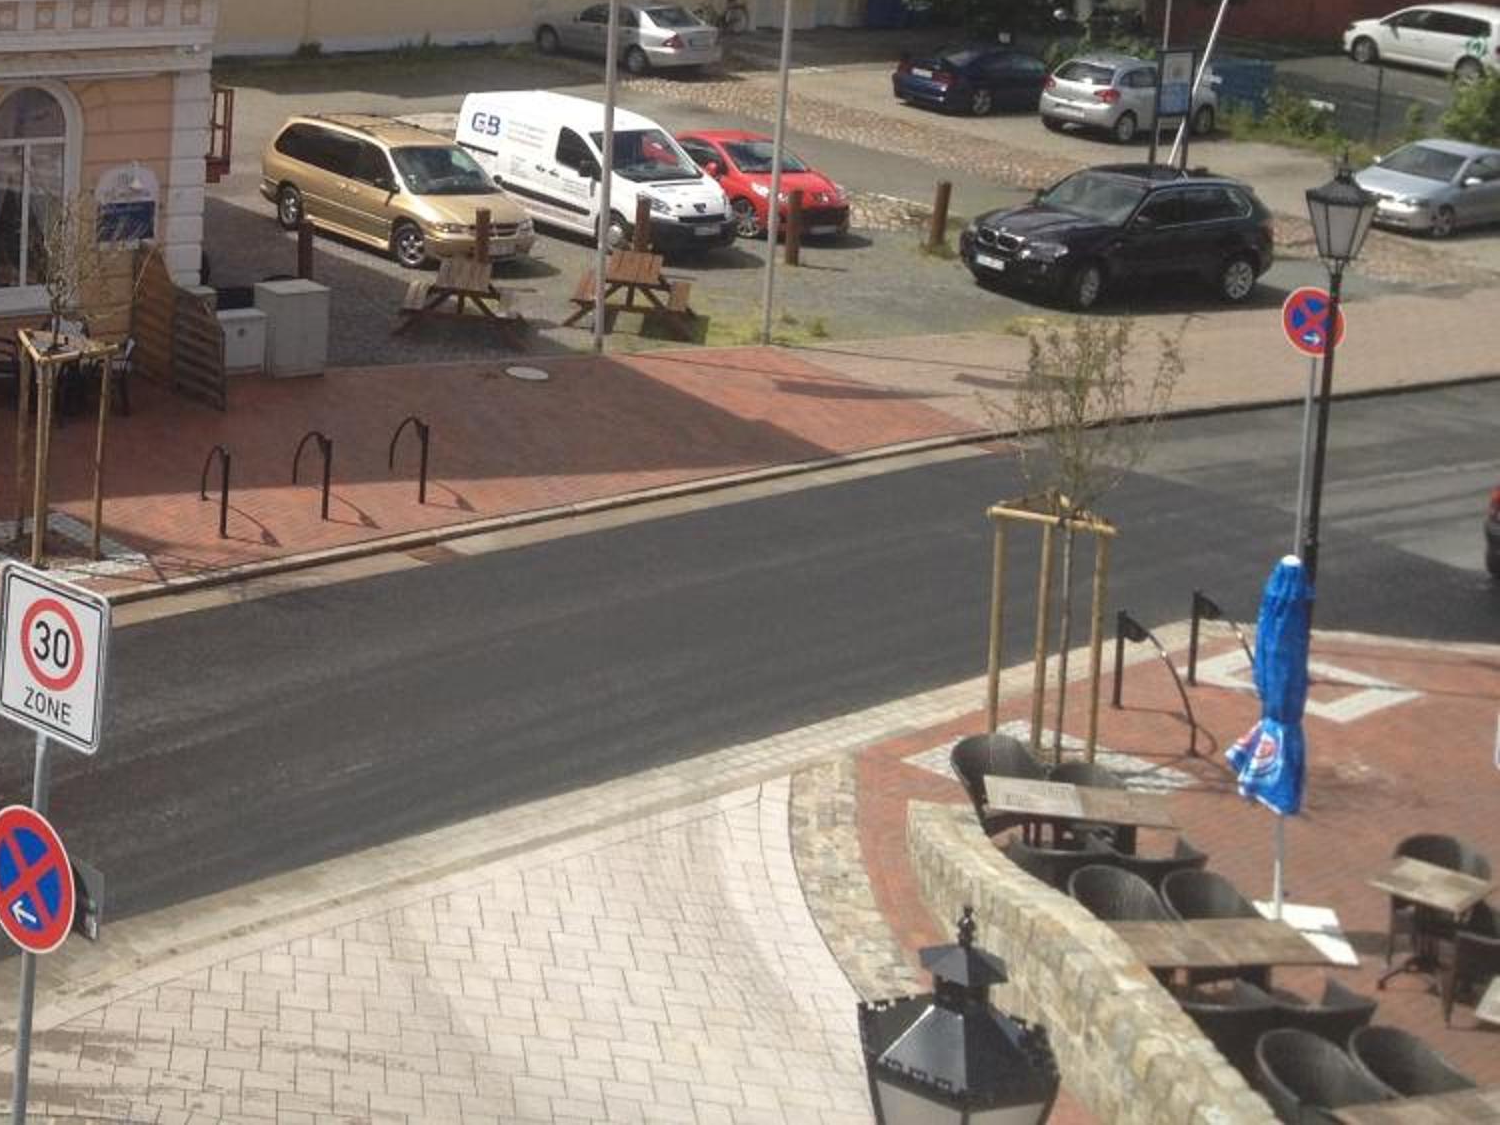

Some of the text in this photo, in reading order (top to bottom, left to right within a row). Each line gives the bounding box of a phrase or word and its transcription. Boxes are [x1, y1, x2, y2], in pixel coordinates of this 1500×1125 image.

[471, 111, 501, 136] GB
[34, 620, 71, 668] 30
[23, 685, 72, 726] ZONE
